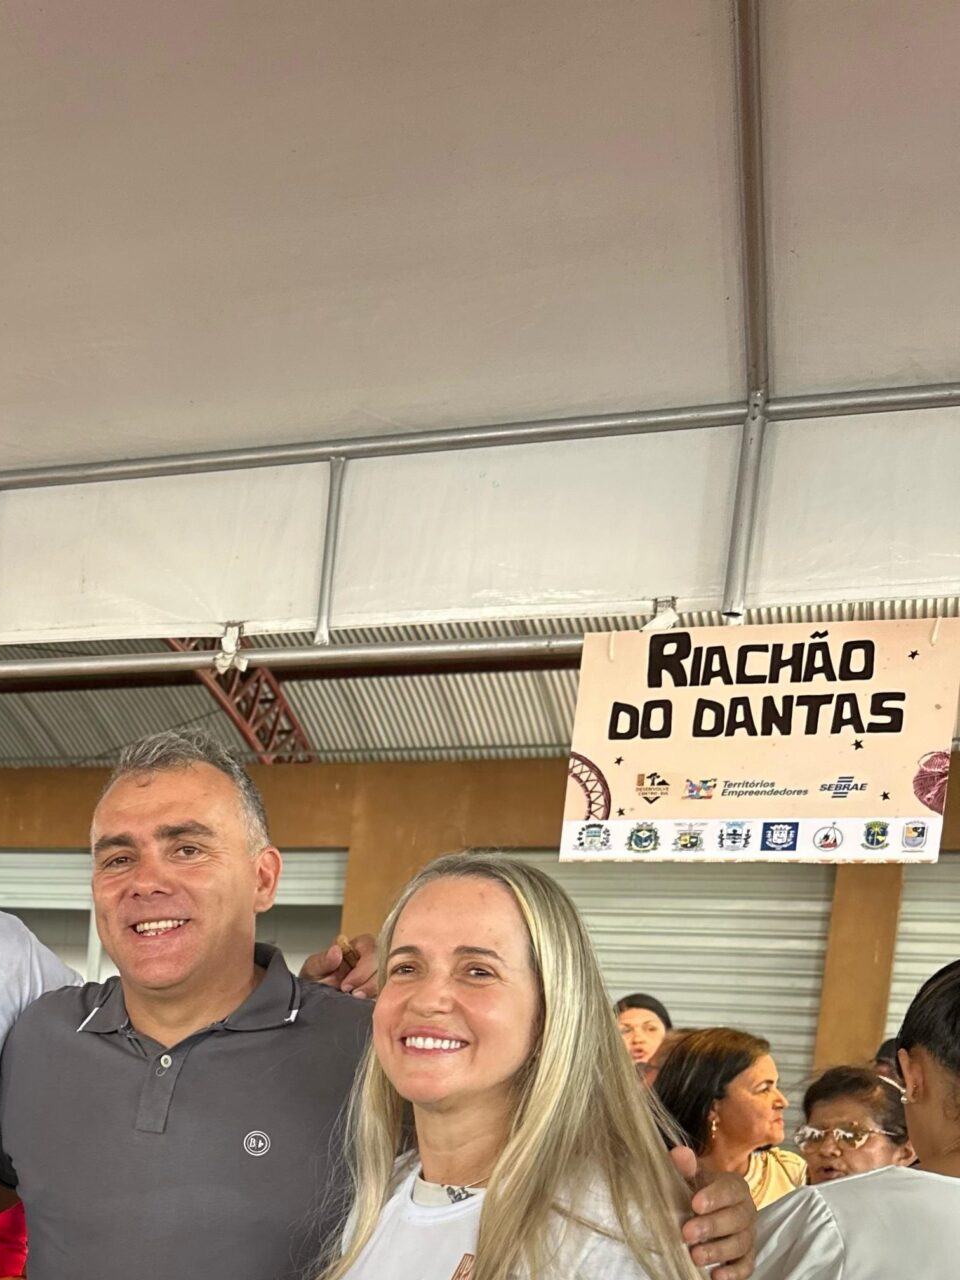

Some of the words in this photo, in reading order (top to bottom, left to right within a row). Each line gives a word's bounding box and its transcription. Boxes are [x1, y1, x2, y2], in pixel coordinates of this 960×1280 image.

[646, 630, 875, 688] RIACHÃO
[608, 699, 673, 740] DO
[691, 692, 906, 738] DANTAS
[722, 780, 776, 789] Territórios
[819, 783, 868, 791] SEBRAE
[721, 788, 809, 798] Empreendedores
